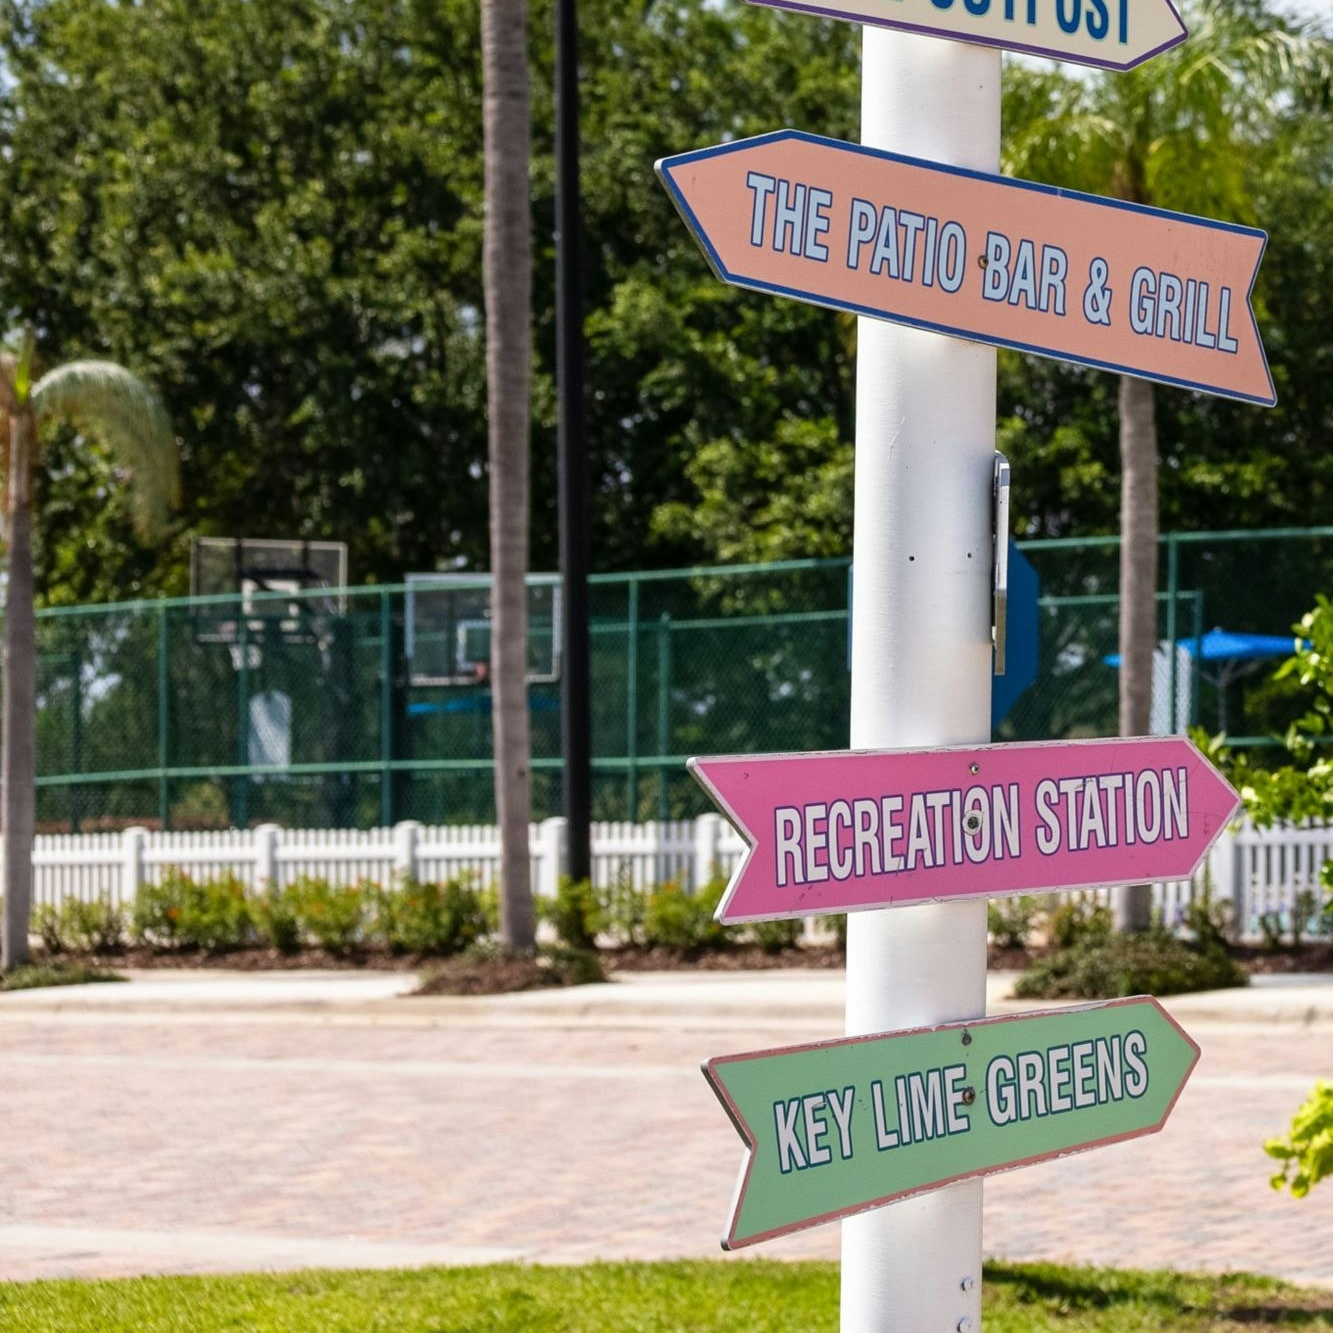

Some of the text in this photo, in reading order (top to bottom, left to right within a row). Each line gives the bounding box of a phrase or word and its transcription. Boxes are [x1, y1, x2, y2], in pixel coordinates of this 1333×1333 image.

[746, 171, 1239, 355] THE PATIO BAR & GRILL
[775, 767, 1189, 888] RECREATION STATION
[774, 1030, 1149, 1173] KEY LIME GREENS
